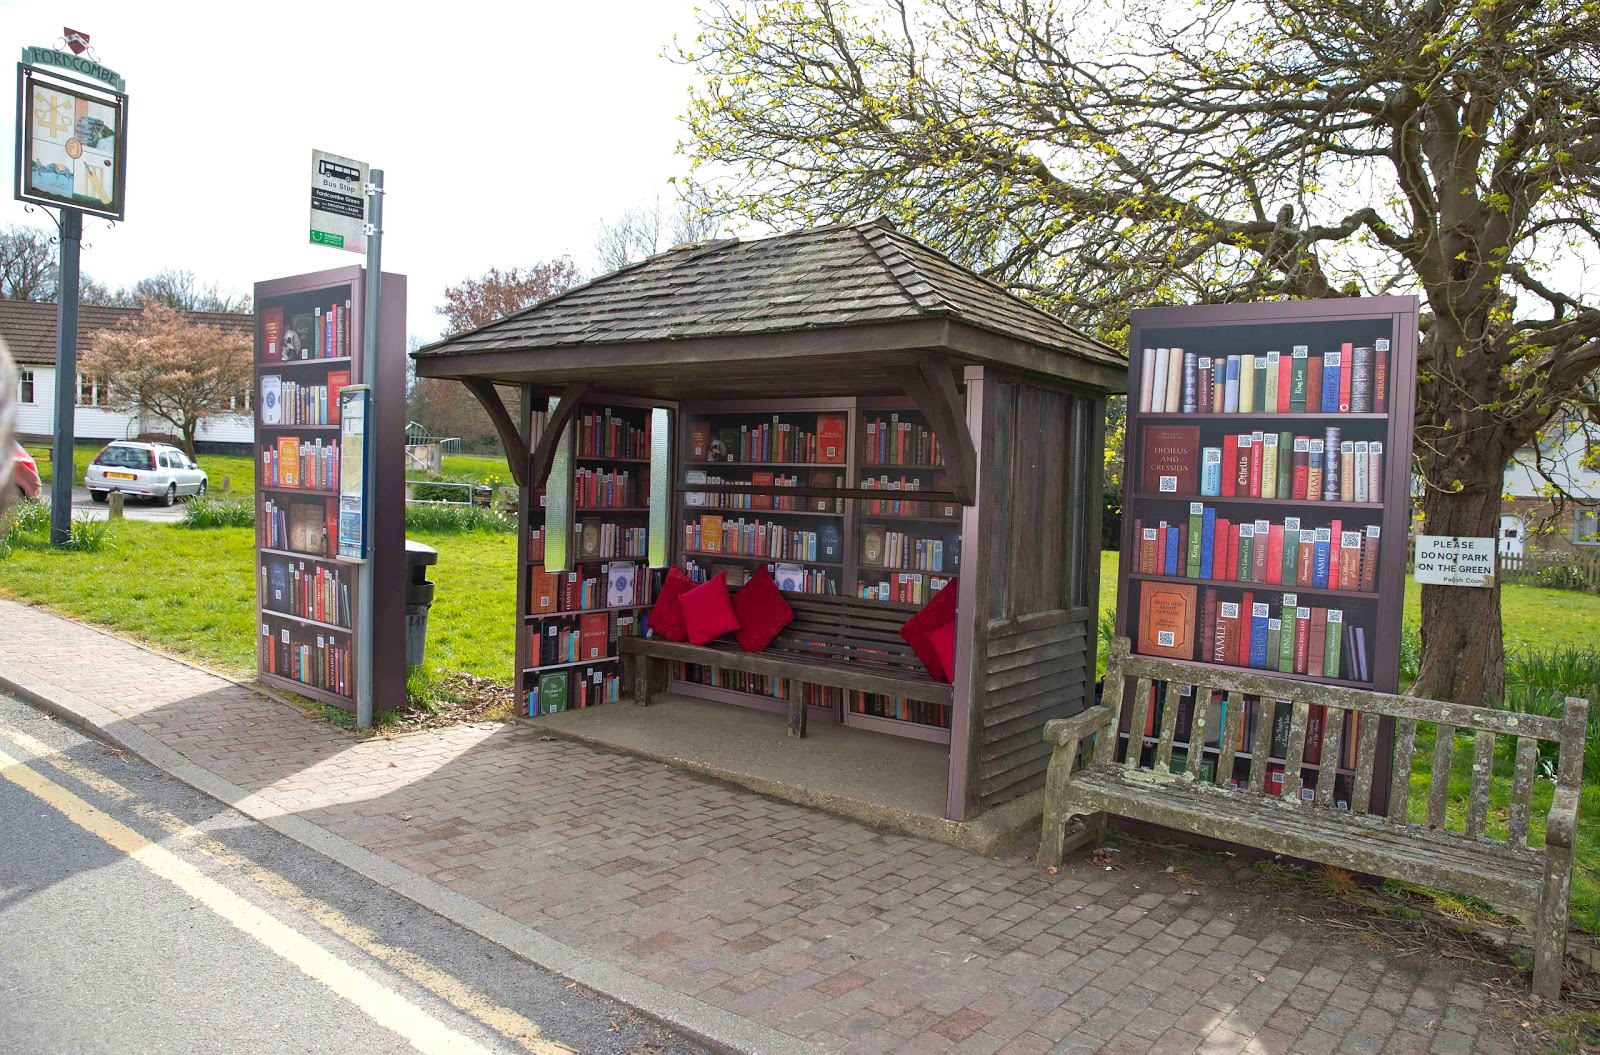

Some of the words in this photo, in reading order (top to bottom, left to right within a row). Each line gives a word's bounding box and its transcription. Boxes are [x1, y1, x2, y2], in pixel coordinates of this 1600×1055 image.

[32, 49, 118, 86] FORDCOMBE
[323, 179, 337, 188] Bus
[339, 183, 355, 194] Stop
[316, 190, 344, 201] Fordcombe
[345, 196, 361, 205] Green
[1295, 369, 1303, 381] Lear
[1377, 369, 1385, 400] RICHARD
[1294, 381, 1303, 394] King
[1326, 381, 1336, 403] Henry
[1150, 464, 1189, 472] CRESSIDA
[1238, 456, 1249, 485] Othello
[1310, 458, 1320, 497] HAMLET
[1295, 474, 1304, 496] Henry
[1191, 531, 1199, 544] Lear
[1433, 541, 1474, 549] PLEASE
[1191, 544, 1200, 558] King
[1256, 544, 1264, 567] Othello
[1437, 552, 1459, 560] NOT
[1461, 553, 1488, 562] PARK
[1316, 547, 1326, 577] HAMLET
[1364, 551, 1374, 581] RICHARD
[1418, 563, 1434, 571] ON
[1437, 564, 1456, 572] THE
[1458, 565, 1491, 574] GREEN
[1465, 577, 1490, 585] Council
[1283, 613, 1292, 633] LEAR
[1214, 618, 1227, 662] HAMLET
[1283, 634, 1291, 655] KING
[1178, 712, 1186, 734] Richard
